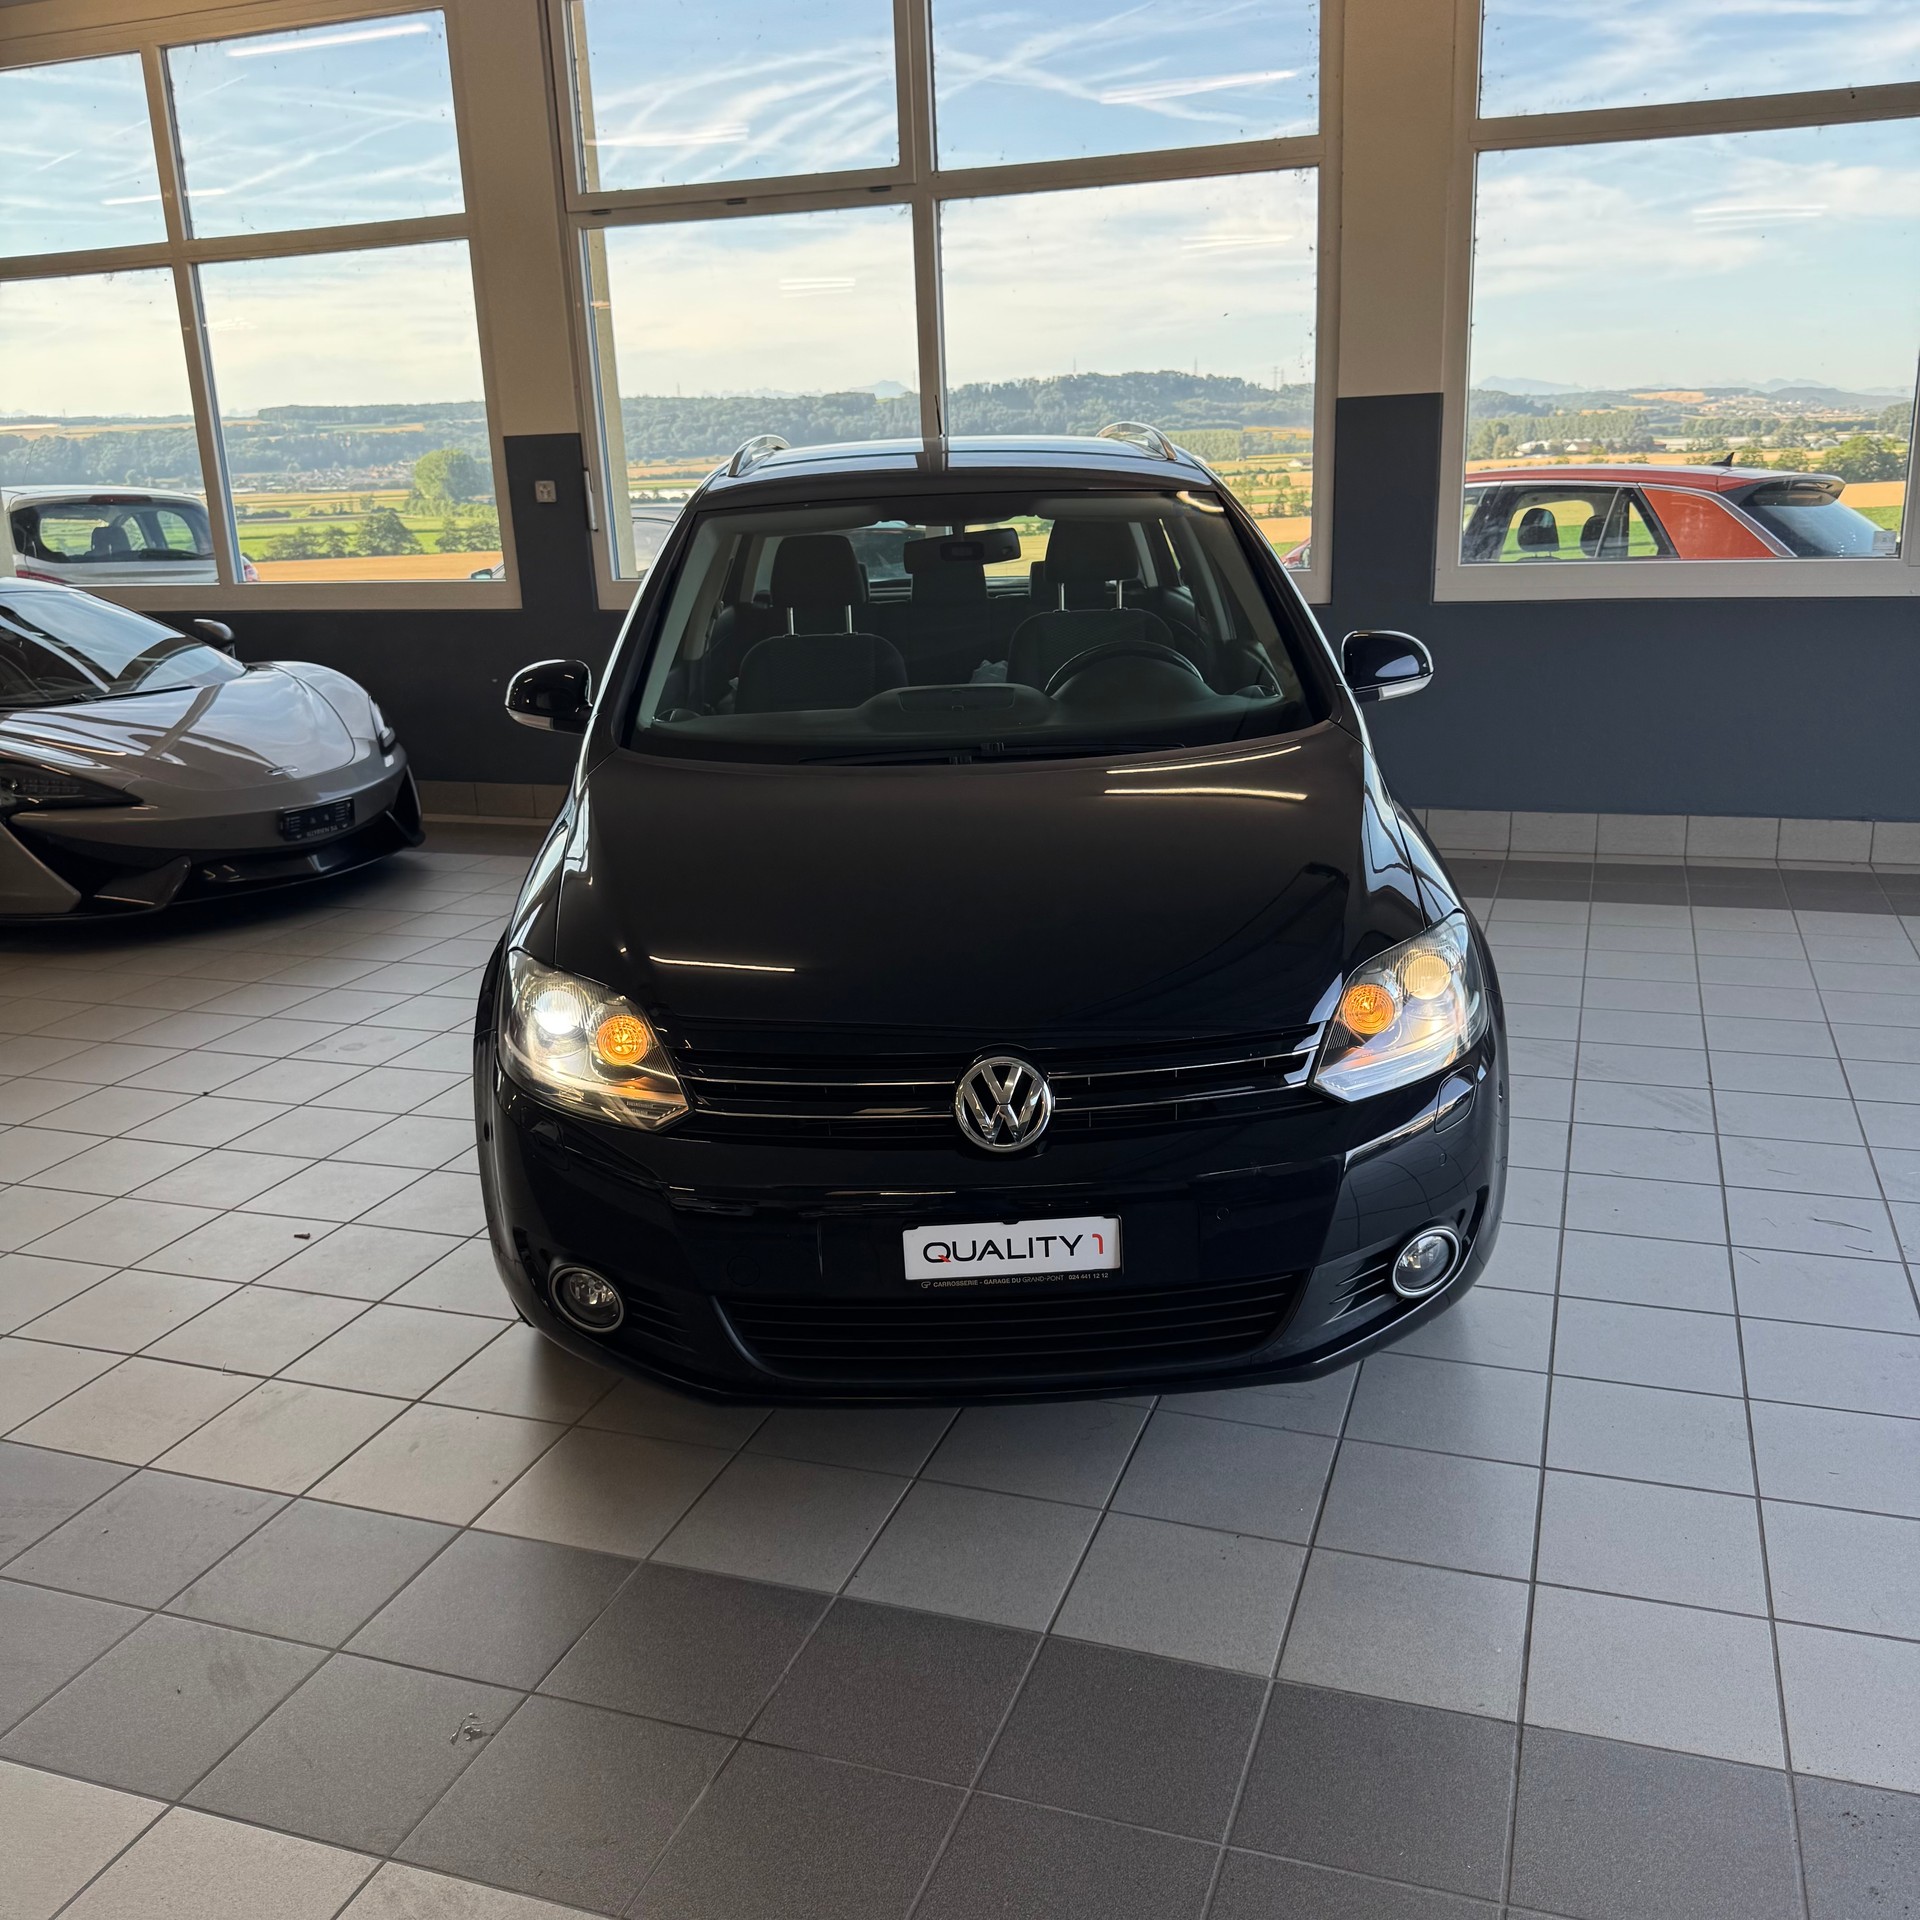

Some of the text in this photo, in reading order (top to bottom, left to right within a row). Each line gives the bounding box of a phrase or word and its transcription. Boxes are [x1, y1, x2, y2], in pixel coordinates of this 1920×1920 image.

[957, 1057, 1049, 1151] VW
[923, 1233, 1104, 1263] QUALITY 1
[933, 1279, 979, 1288] CARROSSERIE
[983, 1277, 1010, 1285] GARAGE
[1022, 1274, 1064, 1283] GRAND-PONT
